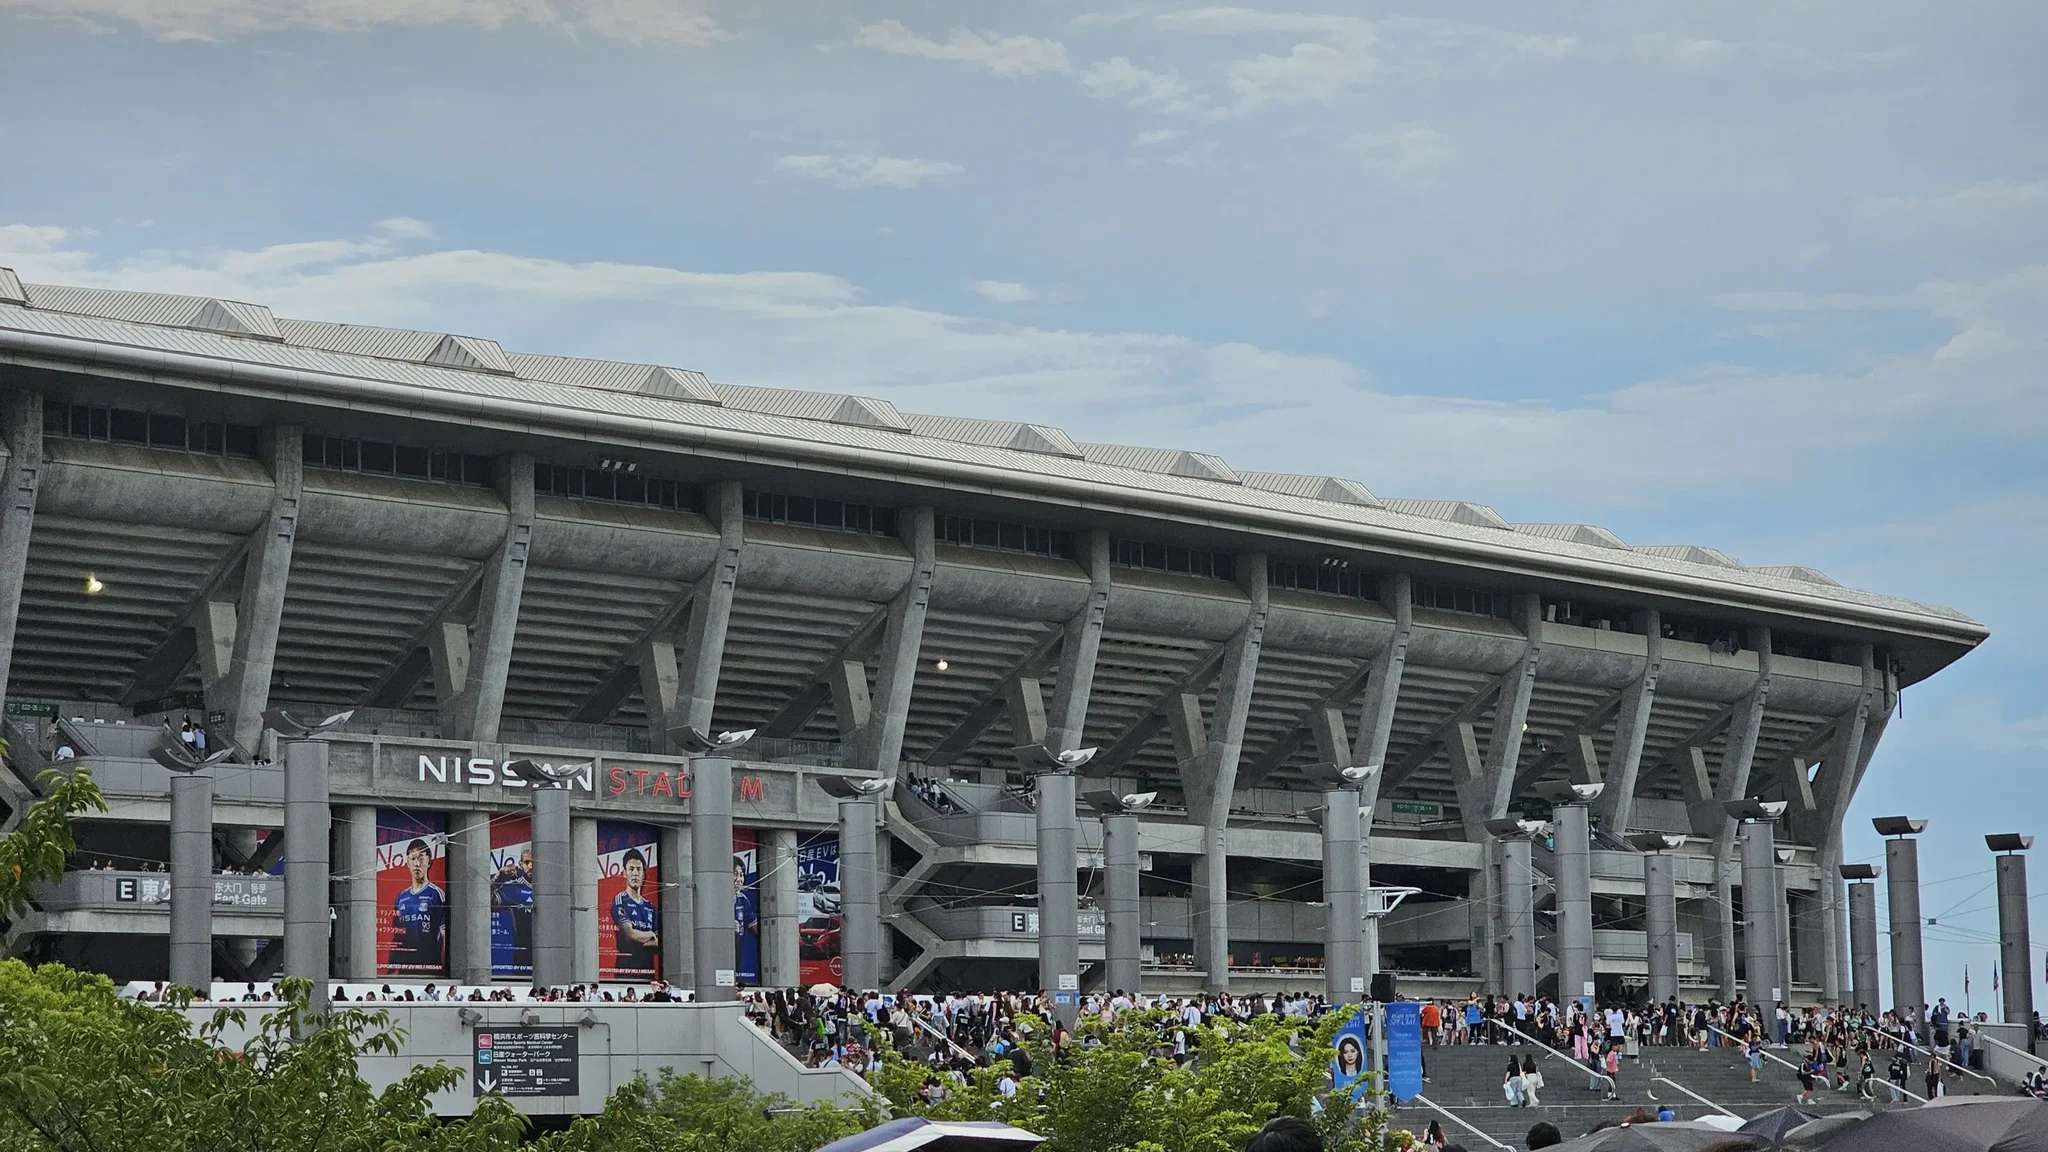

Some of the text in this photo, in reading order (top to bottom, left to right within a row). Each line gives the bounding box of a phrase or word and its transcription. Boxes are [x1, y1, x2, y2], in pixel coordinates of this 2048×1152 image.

[419, 755, 765, 802] NISSAN STADM
[120, 881, 133, 899] E
[214, 882, 242, 894] 东大门
[242, 894, 268, 905] Gate
[421, 922, 431, 930] 90
[1014, 915, 1024, 930] E
[1077, 925, 1106, 935] East Ga
